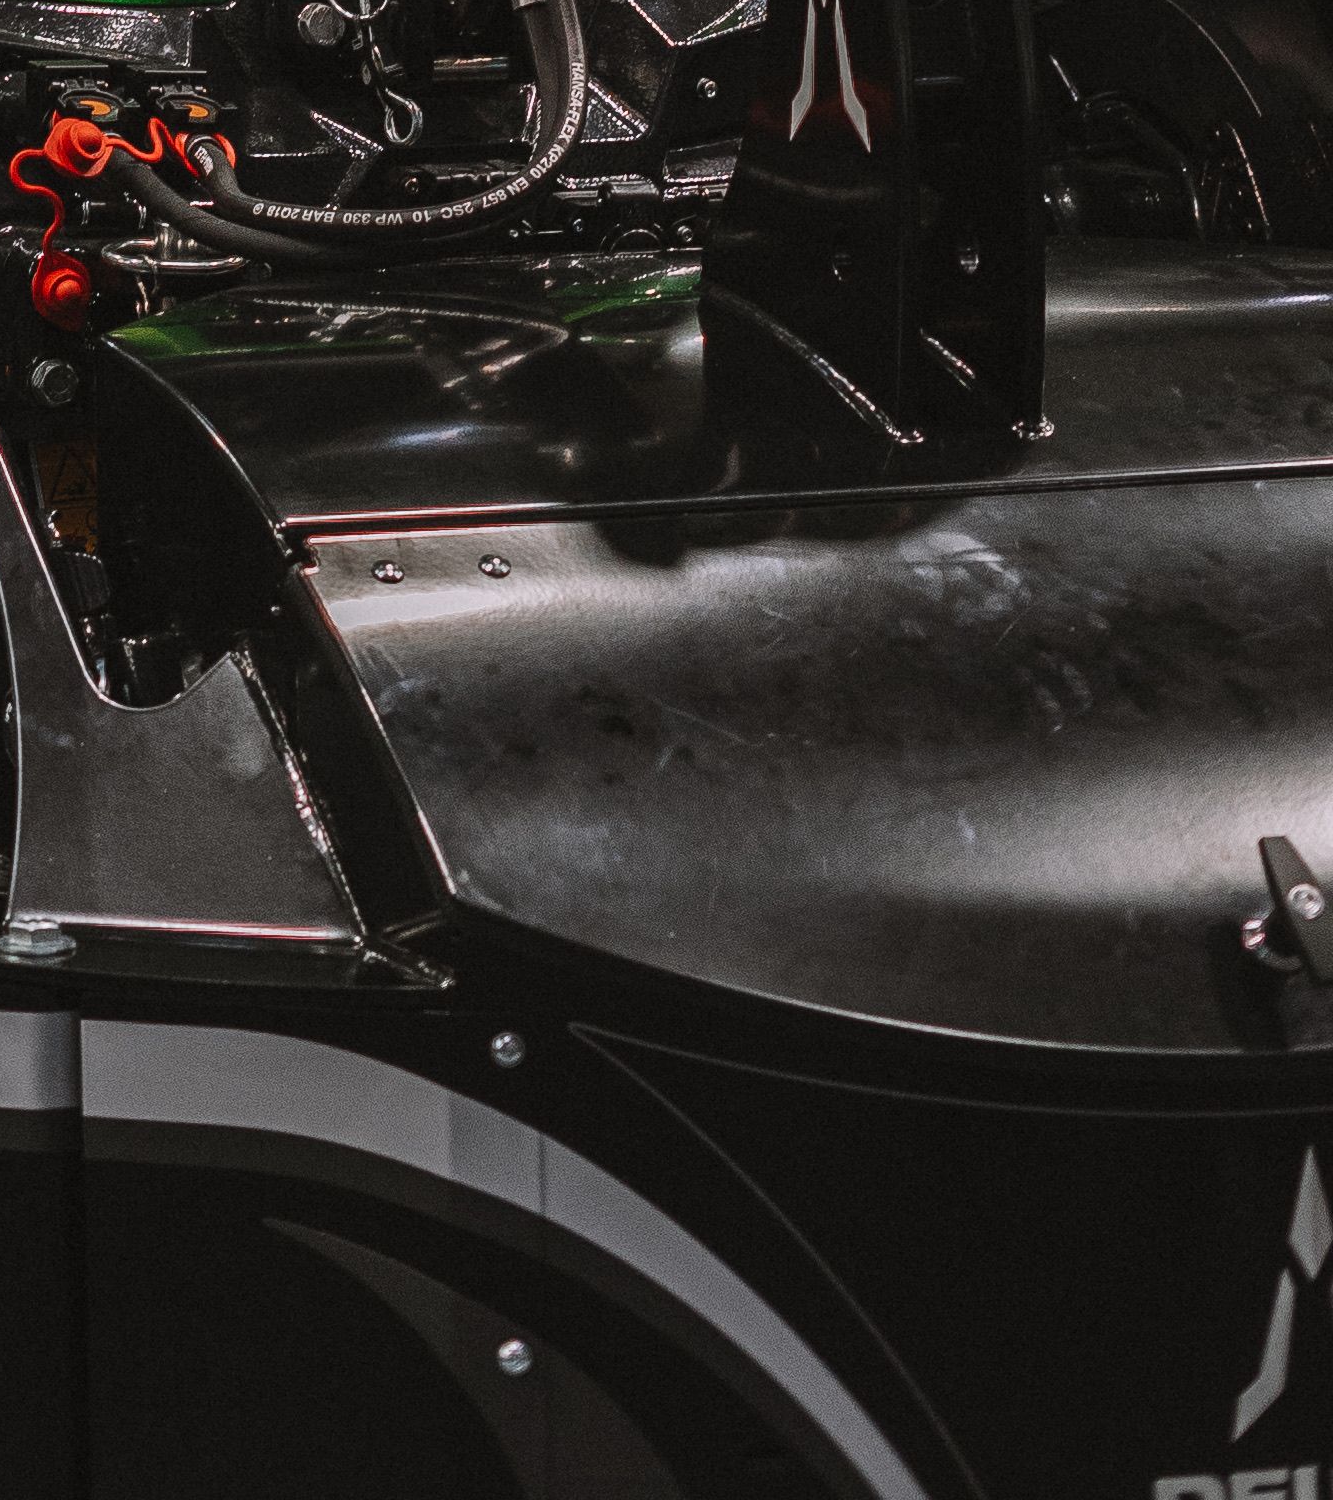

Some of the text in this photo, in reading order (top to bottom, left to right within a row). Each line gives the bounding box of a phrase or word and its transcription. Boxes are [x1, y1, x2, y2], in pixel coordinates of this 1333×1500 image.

[557, 61, 584, 144] HANSA-FLEX
[530, 142, 566, 180] KP210
[506, 176, 531, 197] EN
[482, 186, 509, 210] 857
[301, 208, 336, 224] BAR
[343, 211, 371, 225] 330
[375, 211, 404, 226] WP
[412, 210, 432, 224] 10
[441, 201, 475, 220] 2SC
